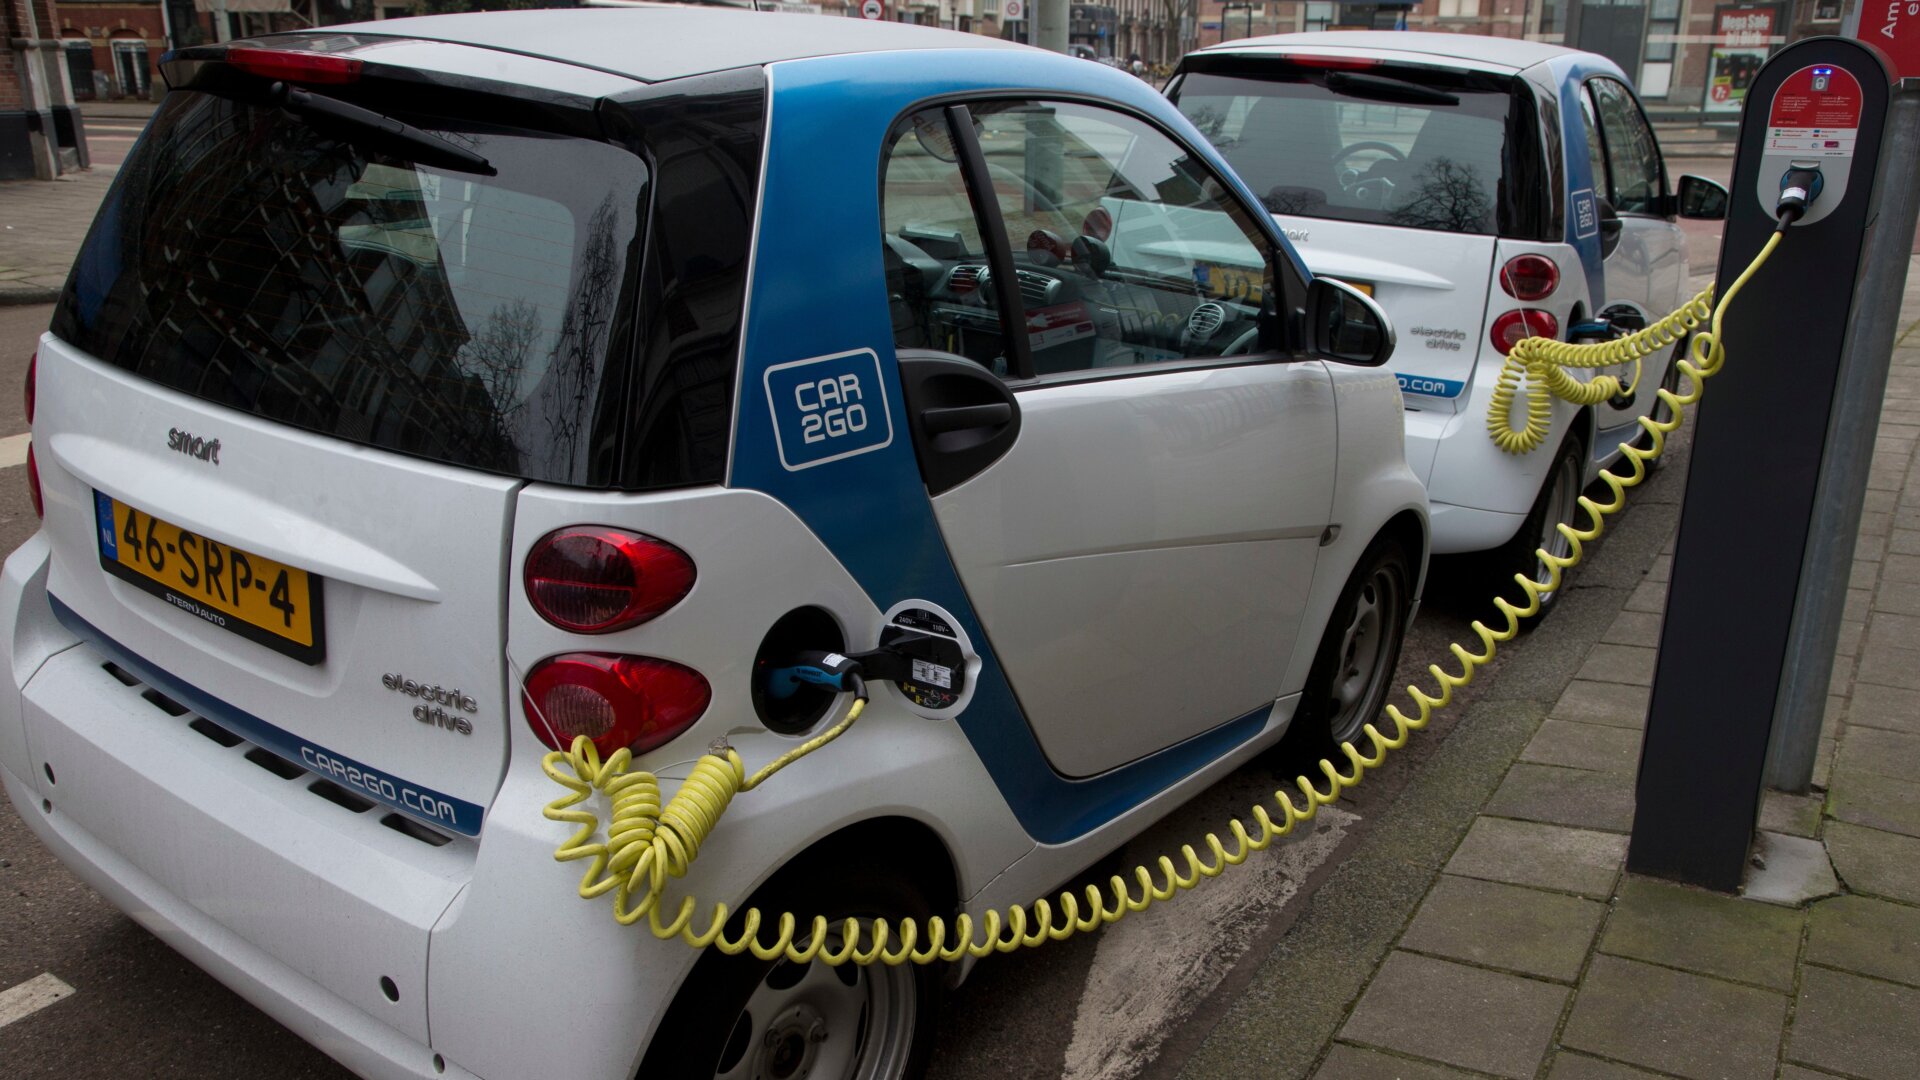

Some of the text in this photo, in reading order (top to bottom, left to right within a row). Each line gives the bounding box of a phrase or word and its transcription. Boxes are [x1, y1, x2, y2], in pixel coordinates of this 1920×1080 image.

[1747, 13, 1770, 30] Sale
[1577, 199, 1592, 214] CAR
[1579, 212, 1593, 228] 2GO
[1282, 228, 1310, 242] art
[1410, 326, 1466, 341] electric
[1425, 338, 1461, 351] drive
[795, 373, 863, 412] CAR
[801, 403, 867, 444] 2GO
[167, 427, 221, 466] smart
[102, 528, 116, 548] NL
[123, 508, 295, 628] 46-SRP-4
[200, 608, 226, 627] AUTO
[382, 672, 478, 713] electric
[412, 703, 473, 735] drive
[301, 746, 457, 824] CAR2GO.COM
